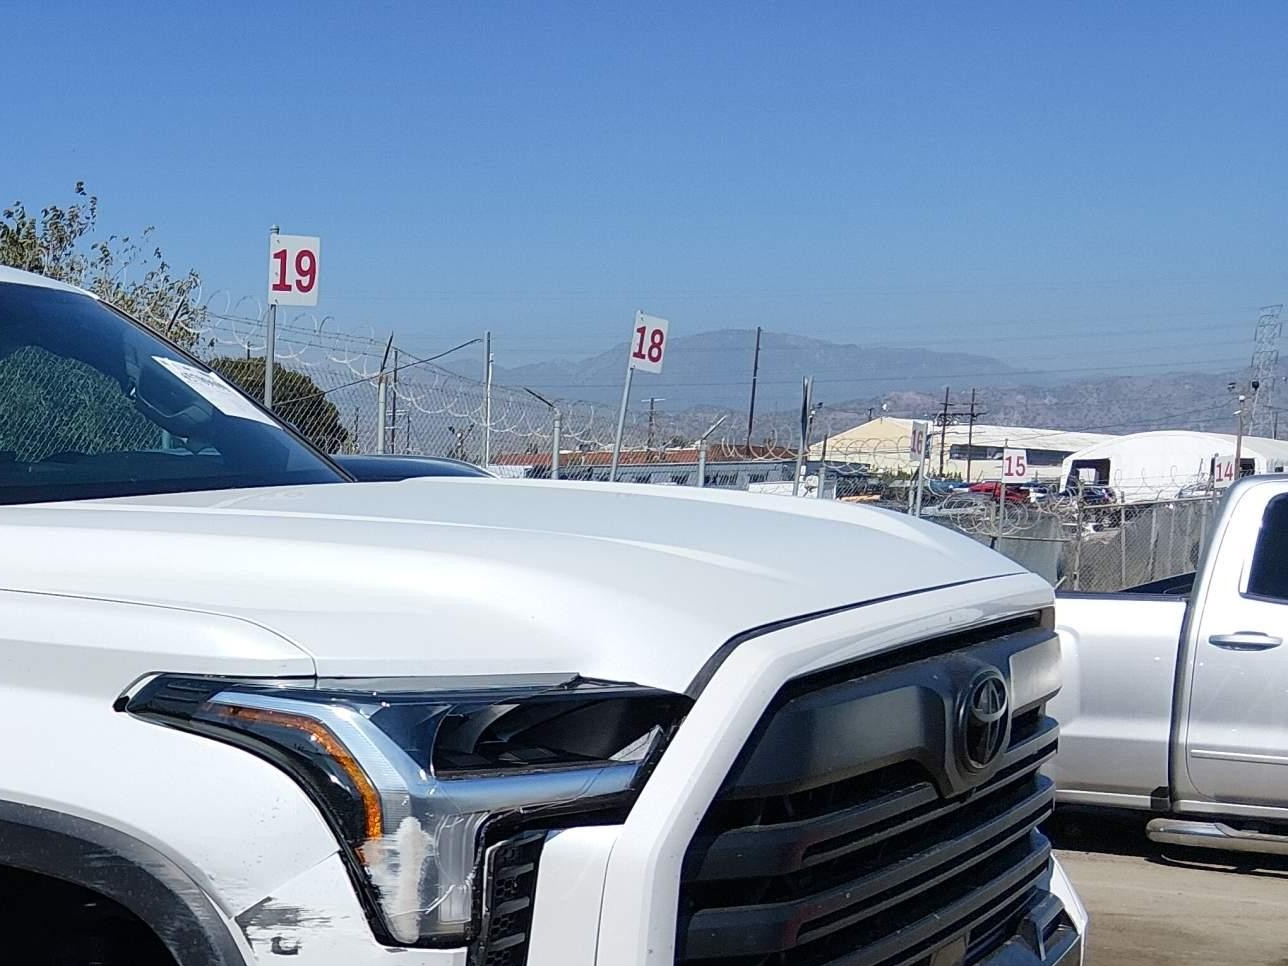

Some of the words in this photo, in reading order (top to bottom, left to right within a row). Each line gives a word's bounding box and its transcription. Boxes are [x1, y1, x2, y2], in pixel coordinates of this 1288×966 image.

[272, 248, 317, 293] 19
[632, 325, 665, 363] 18
[911, 429, 924, 455] 16
[1004, 455, 1026, 477] 15
[1215, 461, 1234, 482] 14
